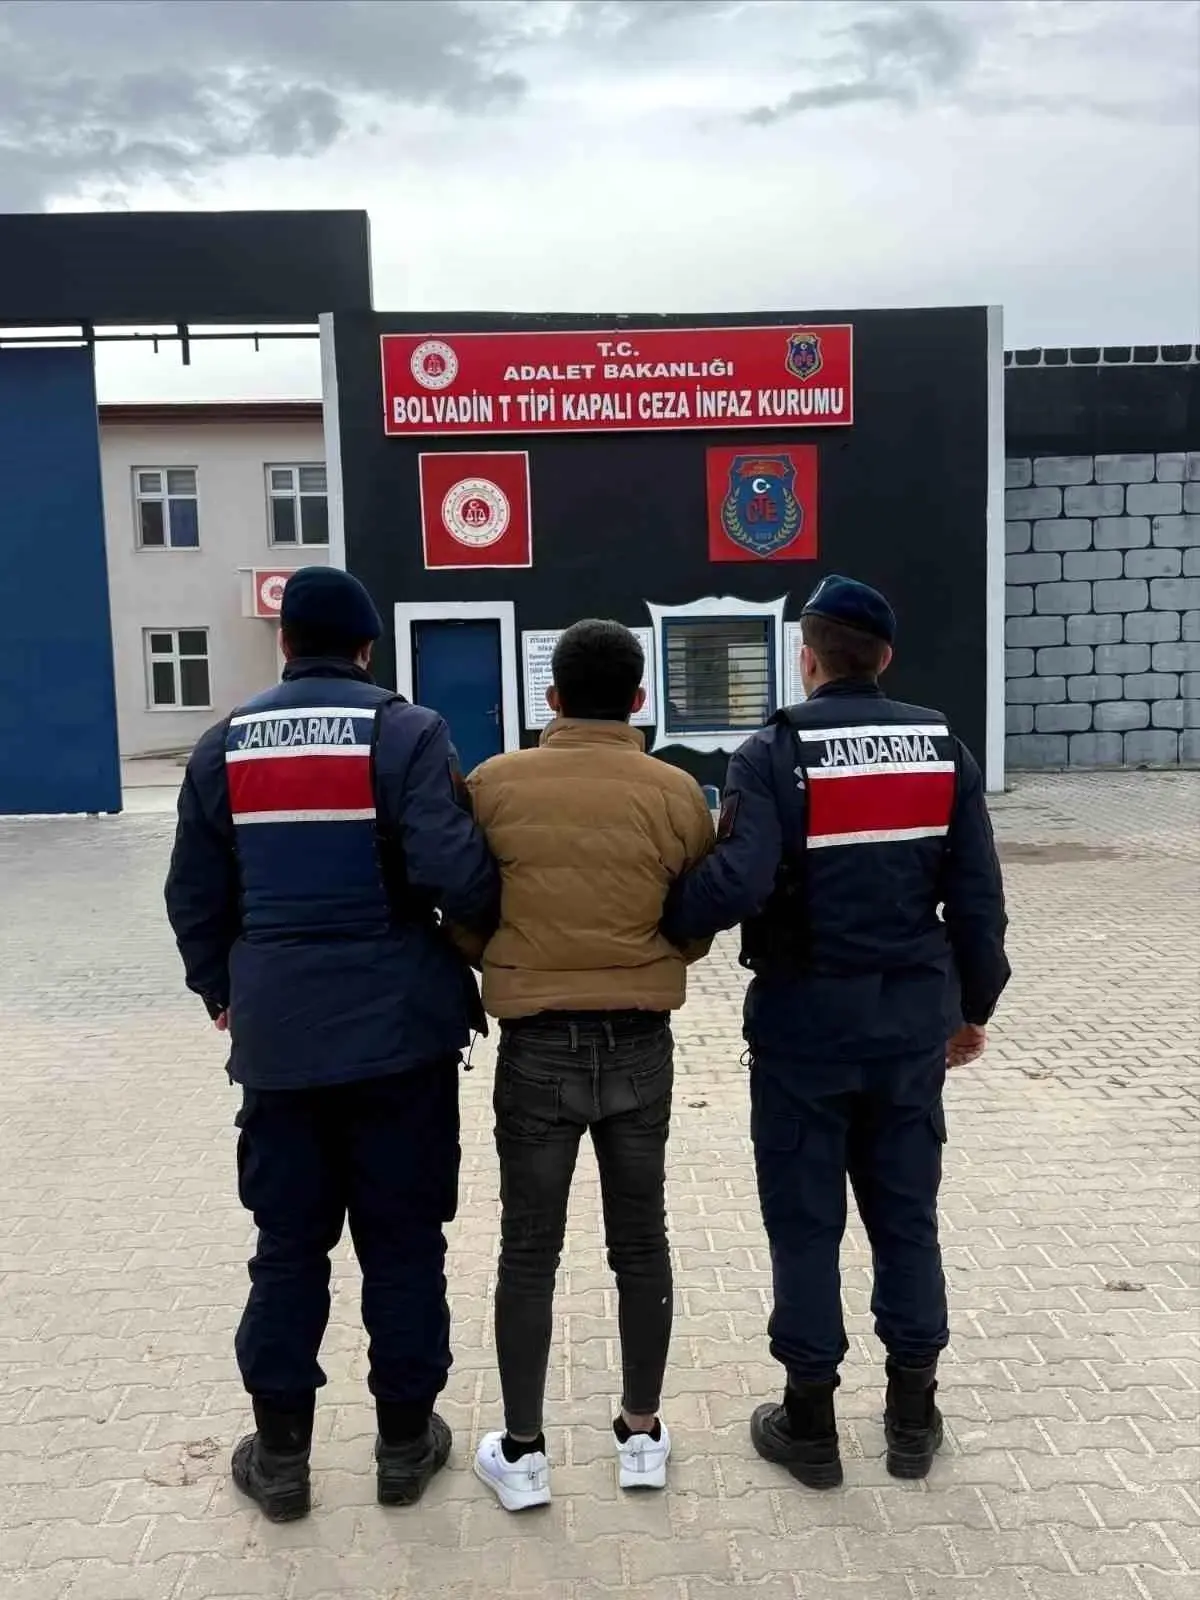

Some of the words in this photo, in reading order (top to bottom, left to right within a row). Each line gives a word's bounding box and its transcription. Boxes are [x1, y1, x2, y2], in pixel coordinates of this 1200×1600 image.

[596, 342, 639, 357] T.C.
[503, 364, 596, 381] ADALET
[603, 358, 734, 379] BAKANLIĞI
[392, 388, 493, 424] BOLVADİN
[498, 395, 511, 422] T
[516, 387, 556, 422] TİPİ
[562, 392, 632, 421] KAPALI
[638, 391, 690, 419] CEZA
[696, 384, 752, 418] İNFAZ
[758, 387, 844, 417] KURUMU
[237, 717, 357, 749] JANDARMA
[820, 735, 939, 767] JANDARMA
